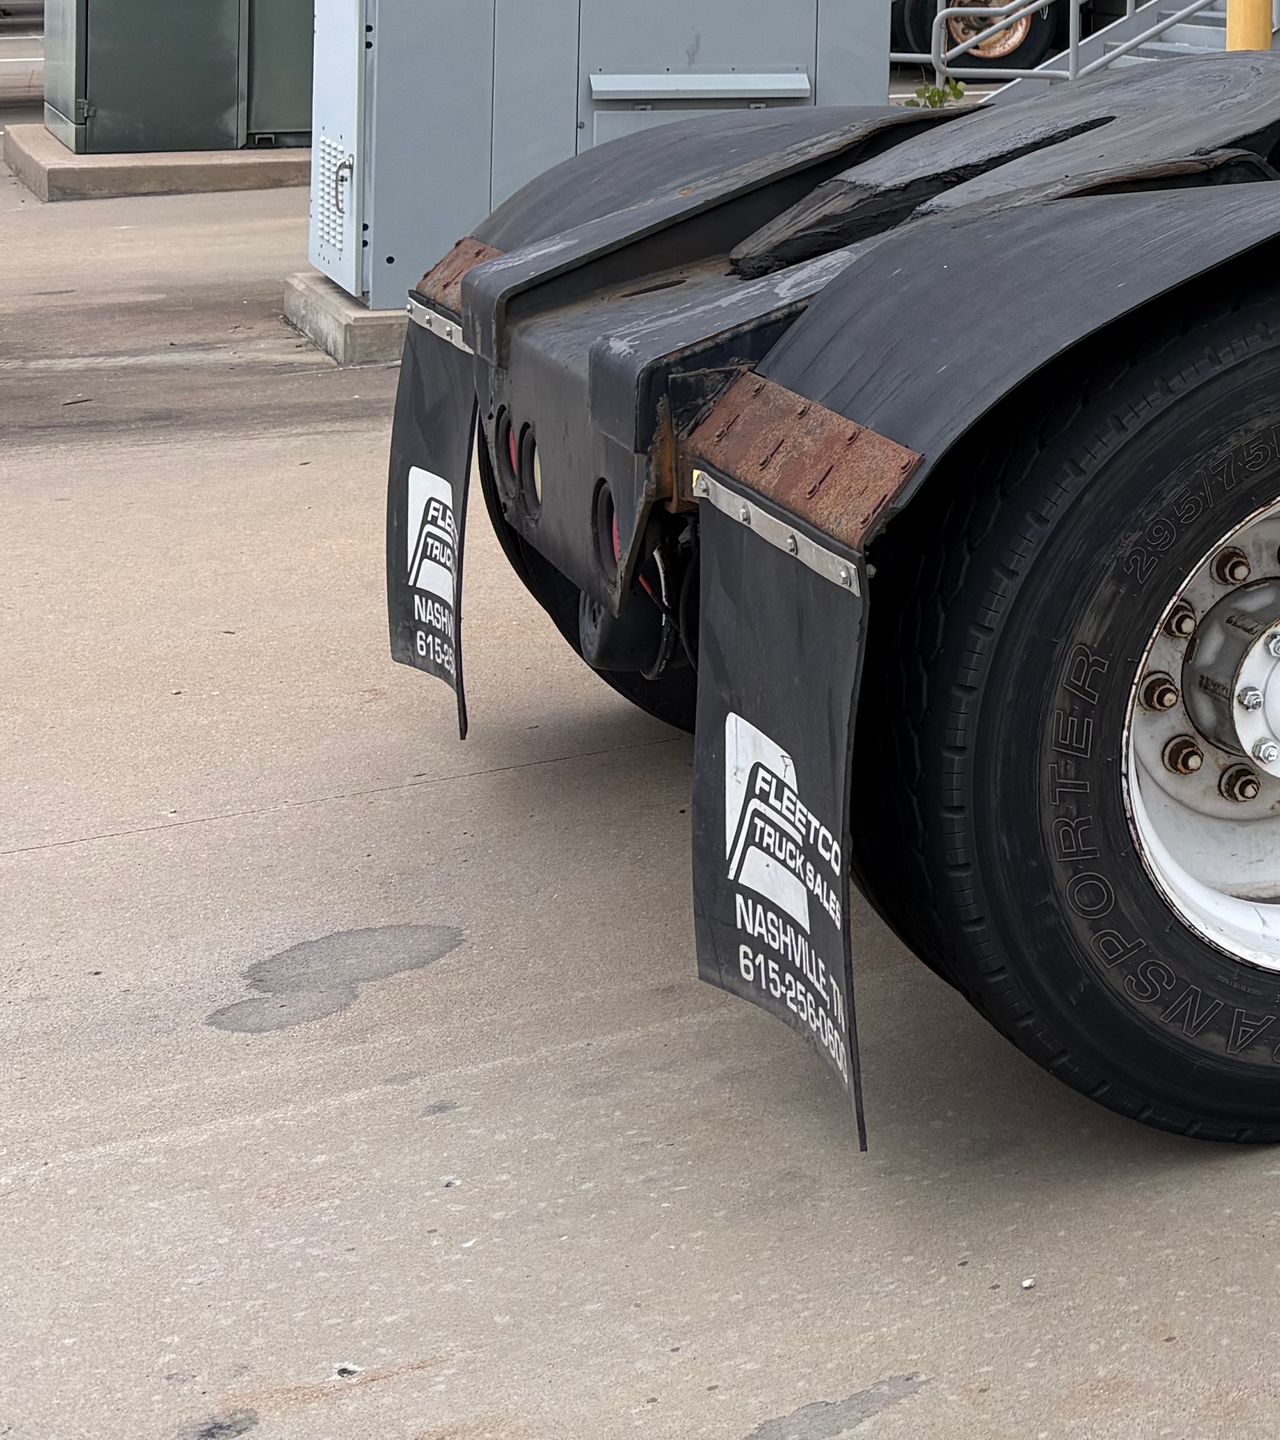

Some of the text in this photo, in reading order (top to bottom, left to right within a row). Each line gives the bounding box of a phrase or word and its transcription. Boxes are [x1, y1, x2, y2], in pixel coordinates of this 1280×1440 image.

[753, 816, 842, 931] TRUCK SALES
[755, 766, 842, 877] FLEETCO
[735, 893, 831, 1010] NASHVILLE,
